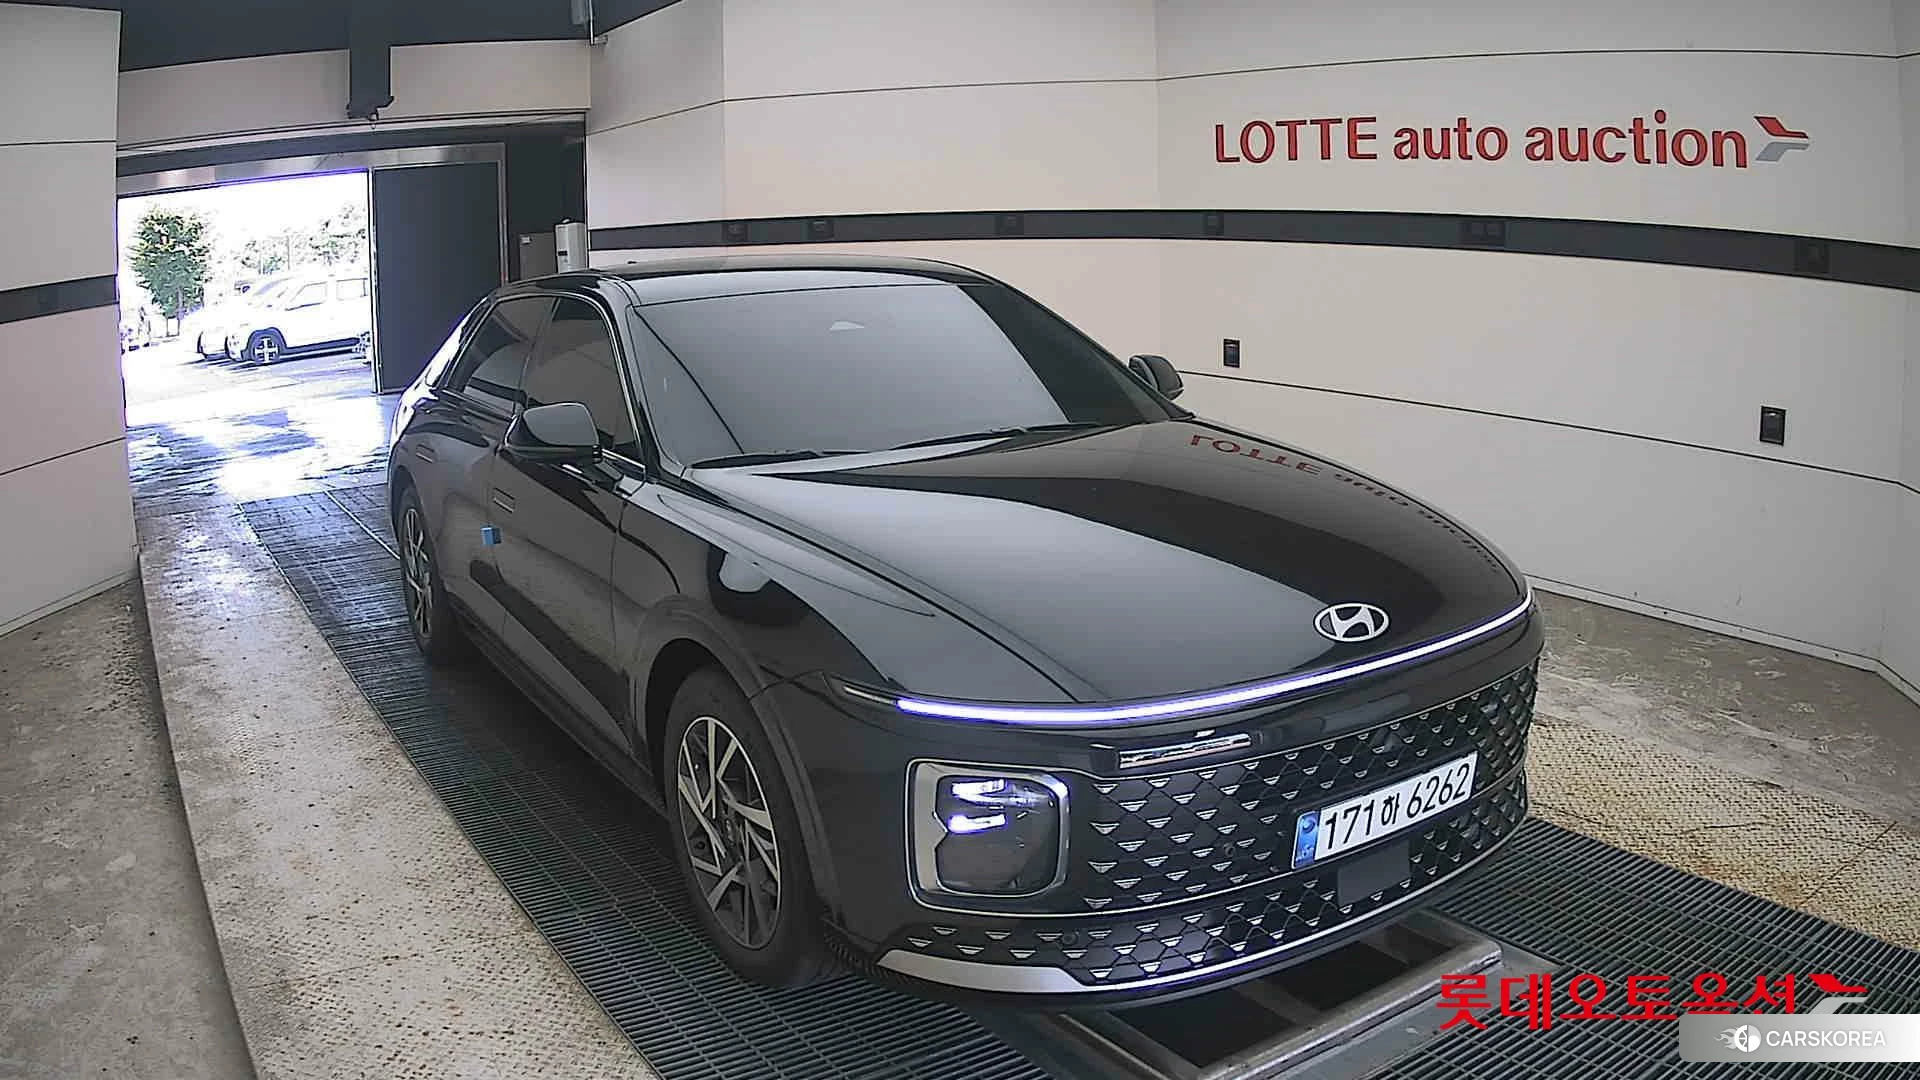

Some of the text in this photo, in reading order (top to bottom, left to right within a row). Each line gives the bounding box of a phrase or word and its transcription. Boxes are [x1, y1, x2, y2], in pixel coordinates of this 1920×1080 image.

[1214, 109, 1748, 169] LOTTE auto auction
[1325, 762, 1470, 850] 171하 6262
